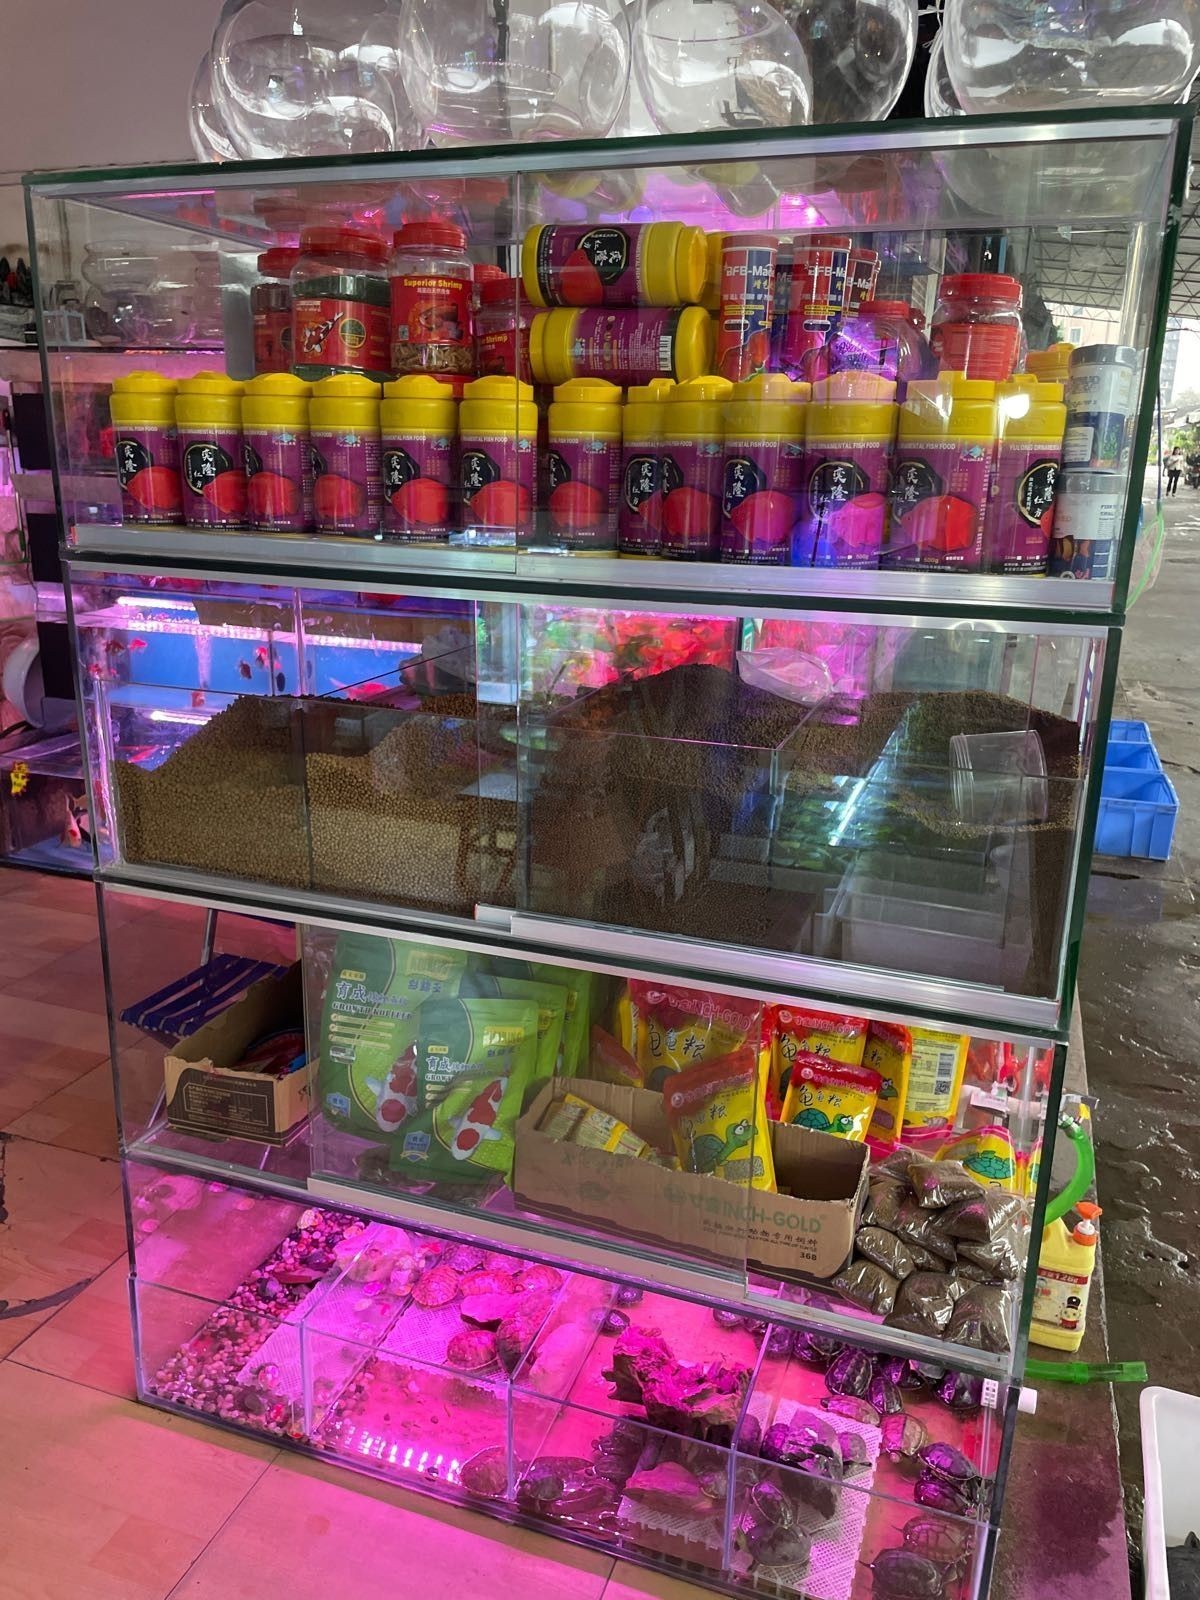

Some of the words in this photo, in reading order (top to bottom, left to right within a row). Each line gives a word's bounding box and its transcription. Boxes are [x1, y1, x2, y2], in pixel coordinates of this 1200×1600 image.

[404, 279, 436, 287] Superior
[438, 280, 463, 290] Shrimp
[336, 981, 367, 1003] 育成
[332, 1001, 371, 1015] GROWTH
[426, 1056, 452, 1073] 育成
[425, 1073, 453, 1082] GROWT
[800, 1252, 817, 1260] 368
